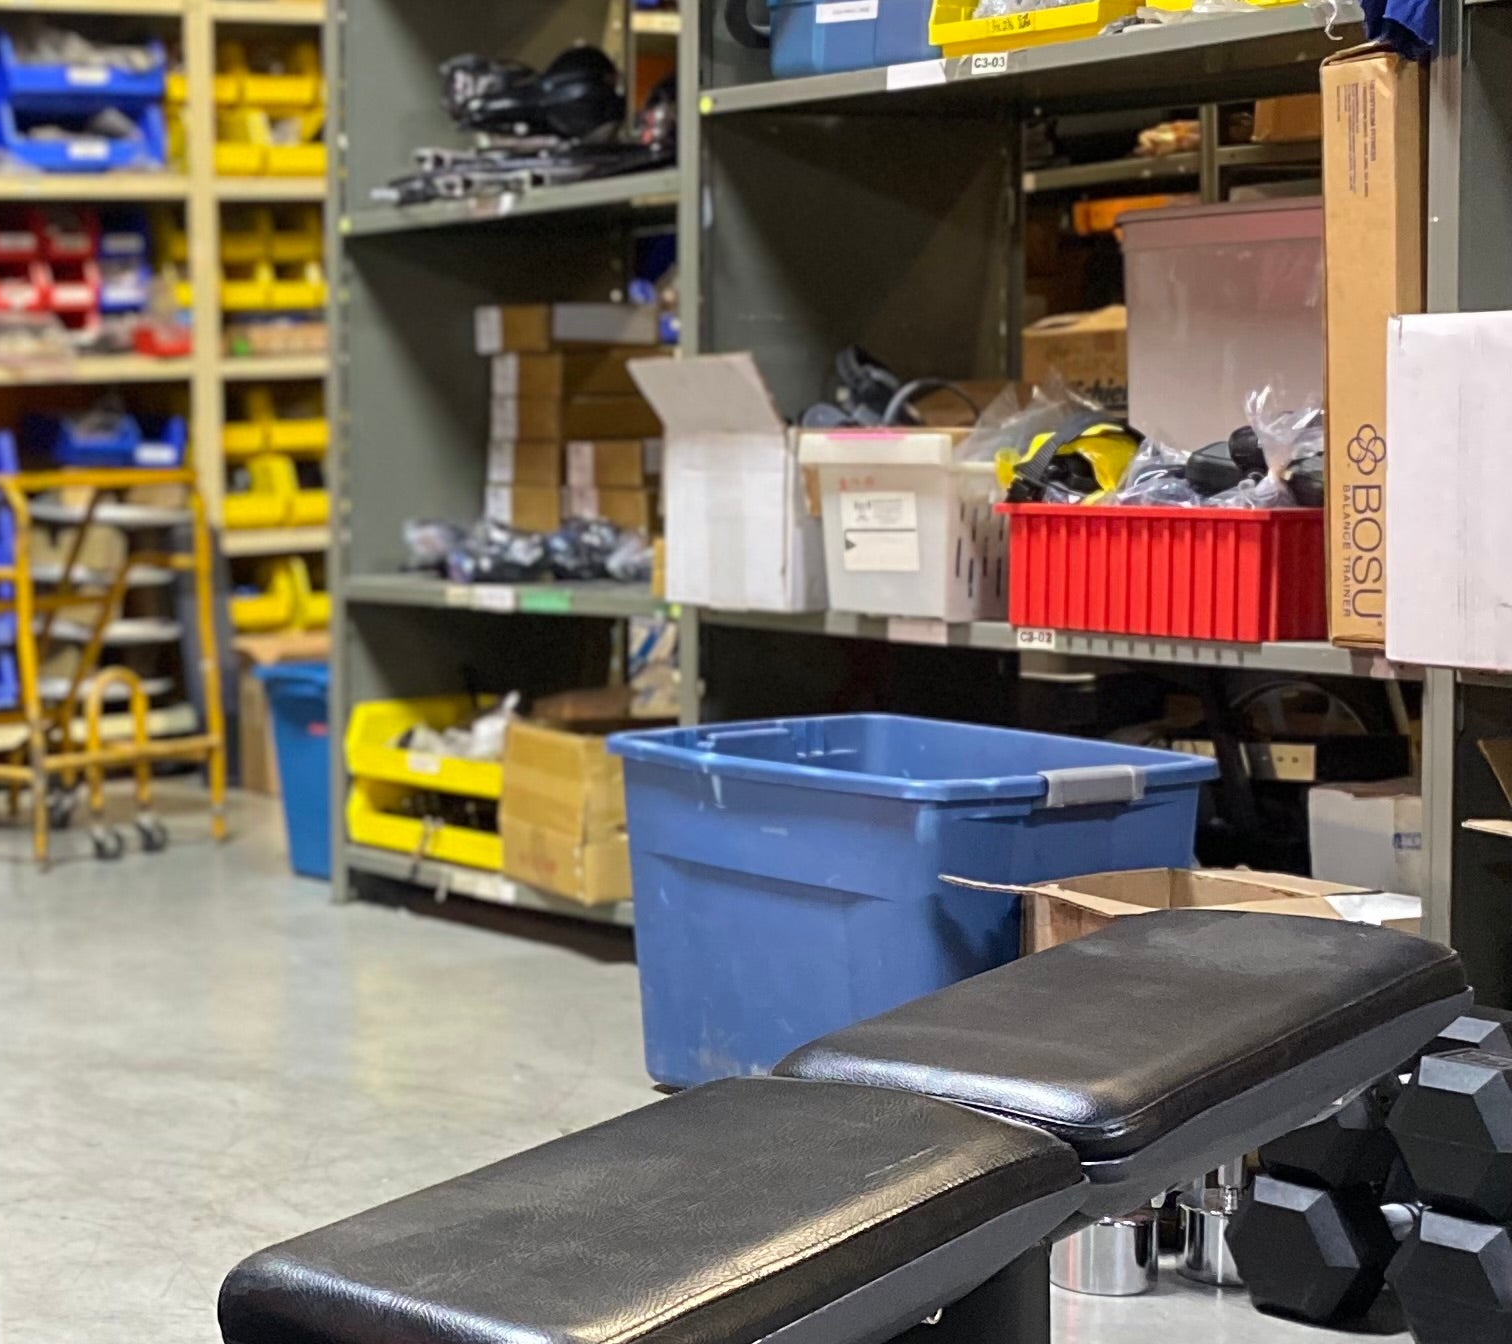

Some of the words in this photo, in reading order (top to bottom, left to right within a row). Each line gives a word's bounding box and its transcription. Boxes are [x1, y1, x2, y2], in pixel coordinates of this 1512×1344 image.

[973, 56, 1005, 69] C3-03
[1342, 484, 1351, 551] BALANCE
[1352, 484, 1383, 618] BOSU
[1342, 557, 1351, 618] TRAINER
